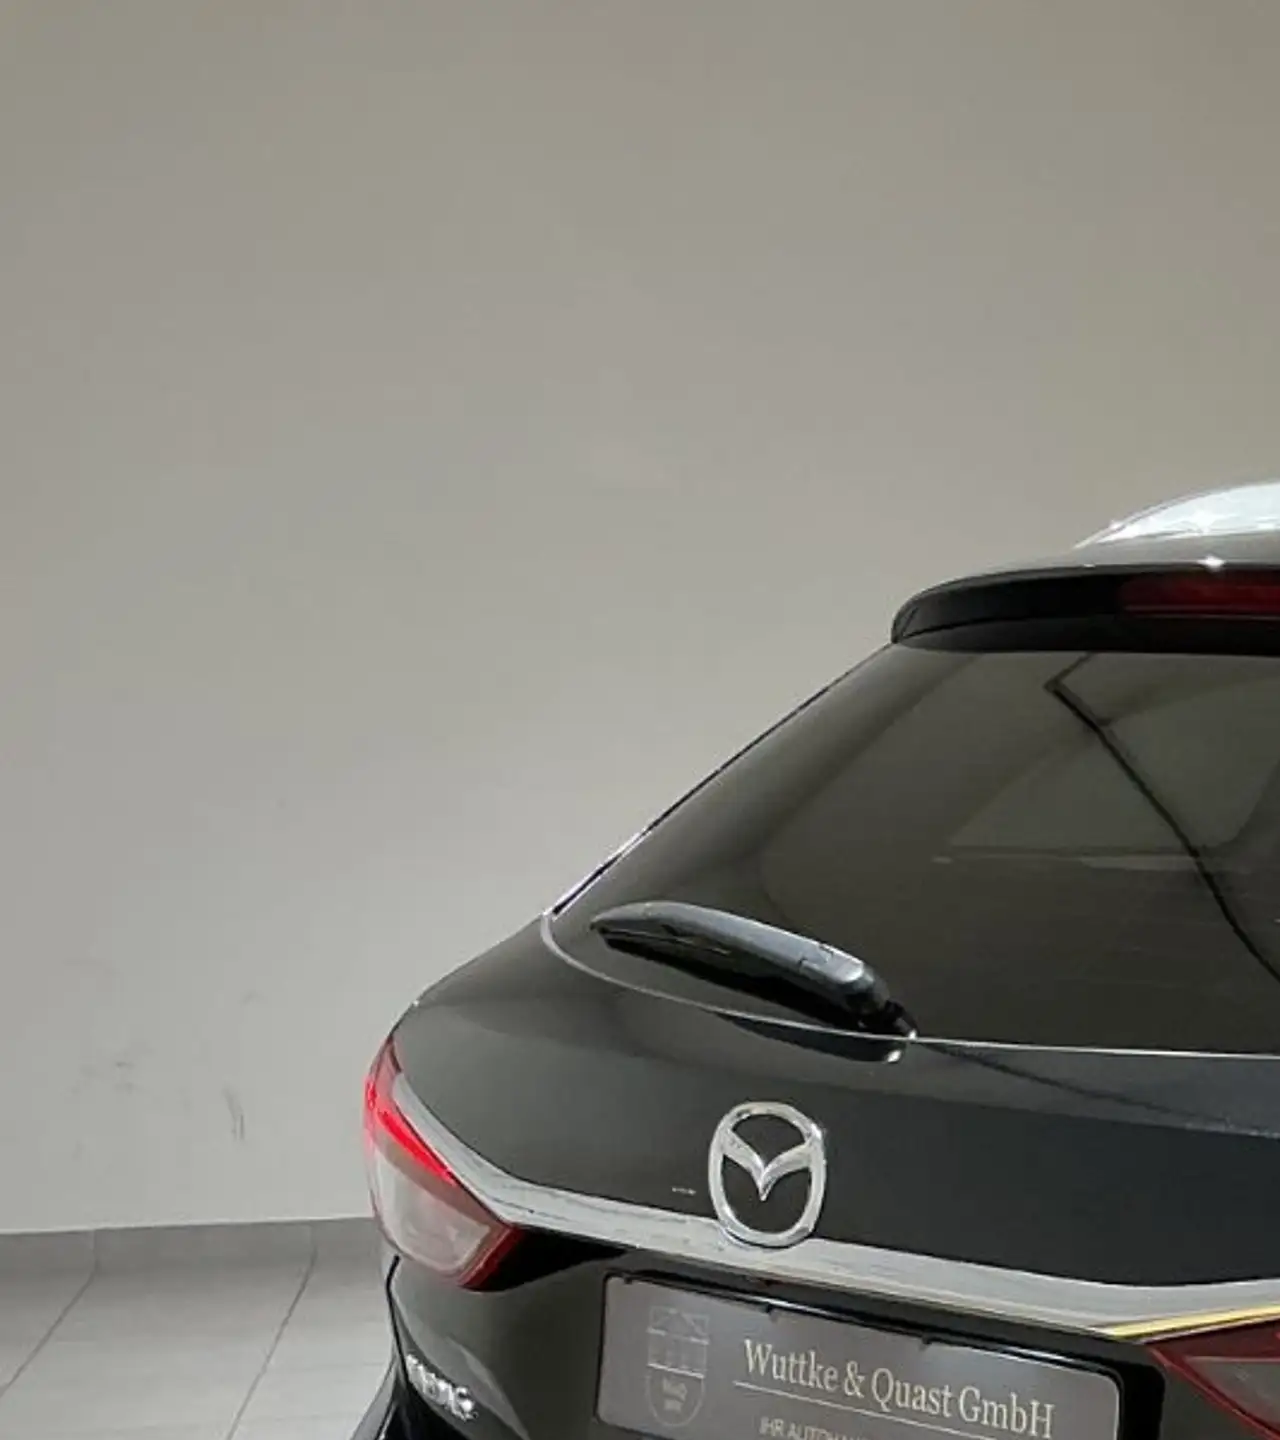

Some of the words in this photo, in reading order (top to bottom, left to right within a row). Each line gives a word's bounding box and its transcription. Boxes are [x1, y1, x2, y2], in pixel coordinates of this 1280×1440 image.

[744, 1338, 839, 1393] Wuttke
[843, 1360, 866, 1399] &
[871, 1367, 953, 1419] Quast
[958, 1385, 1055, 1440] GmbH
[758, 1416, 785, 1437] IHR
